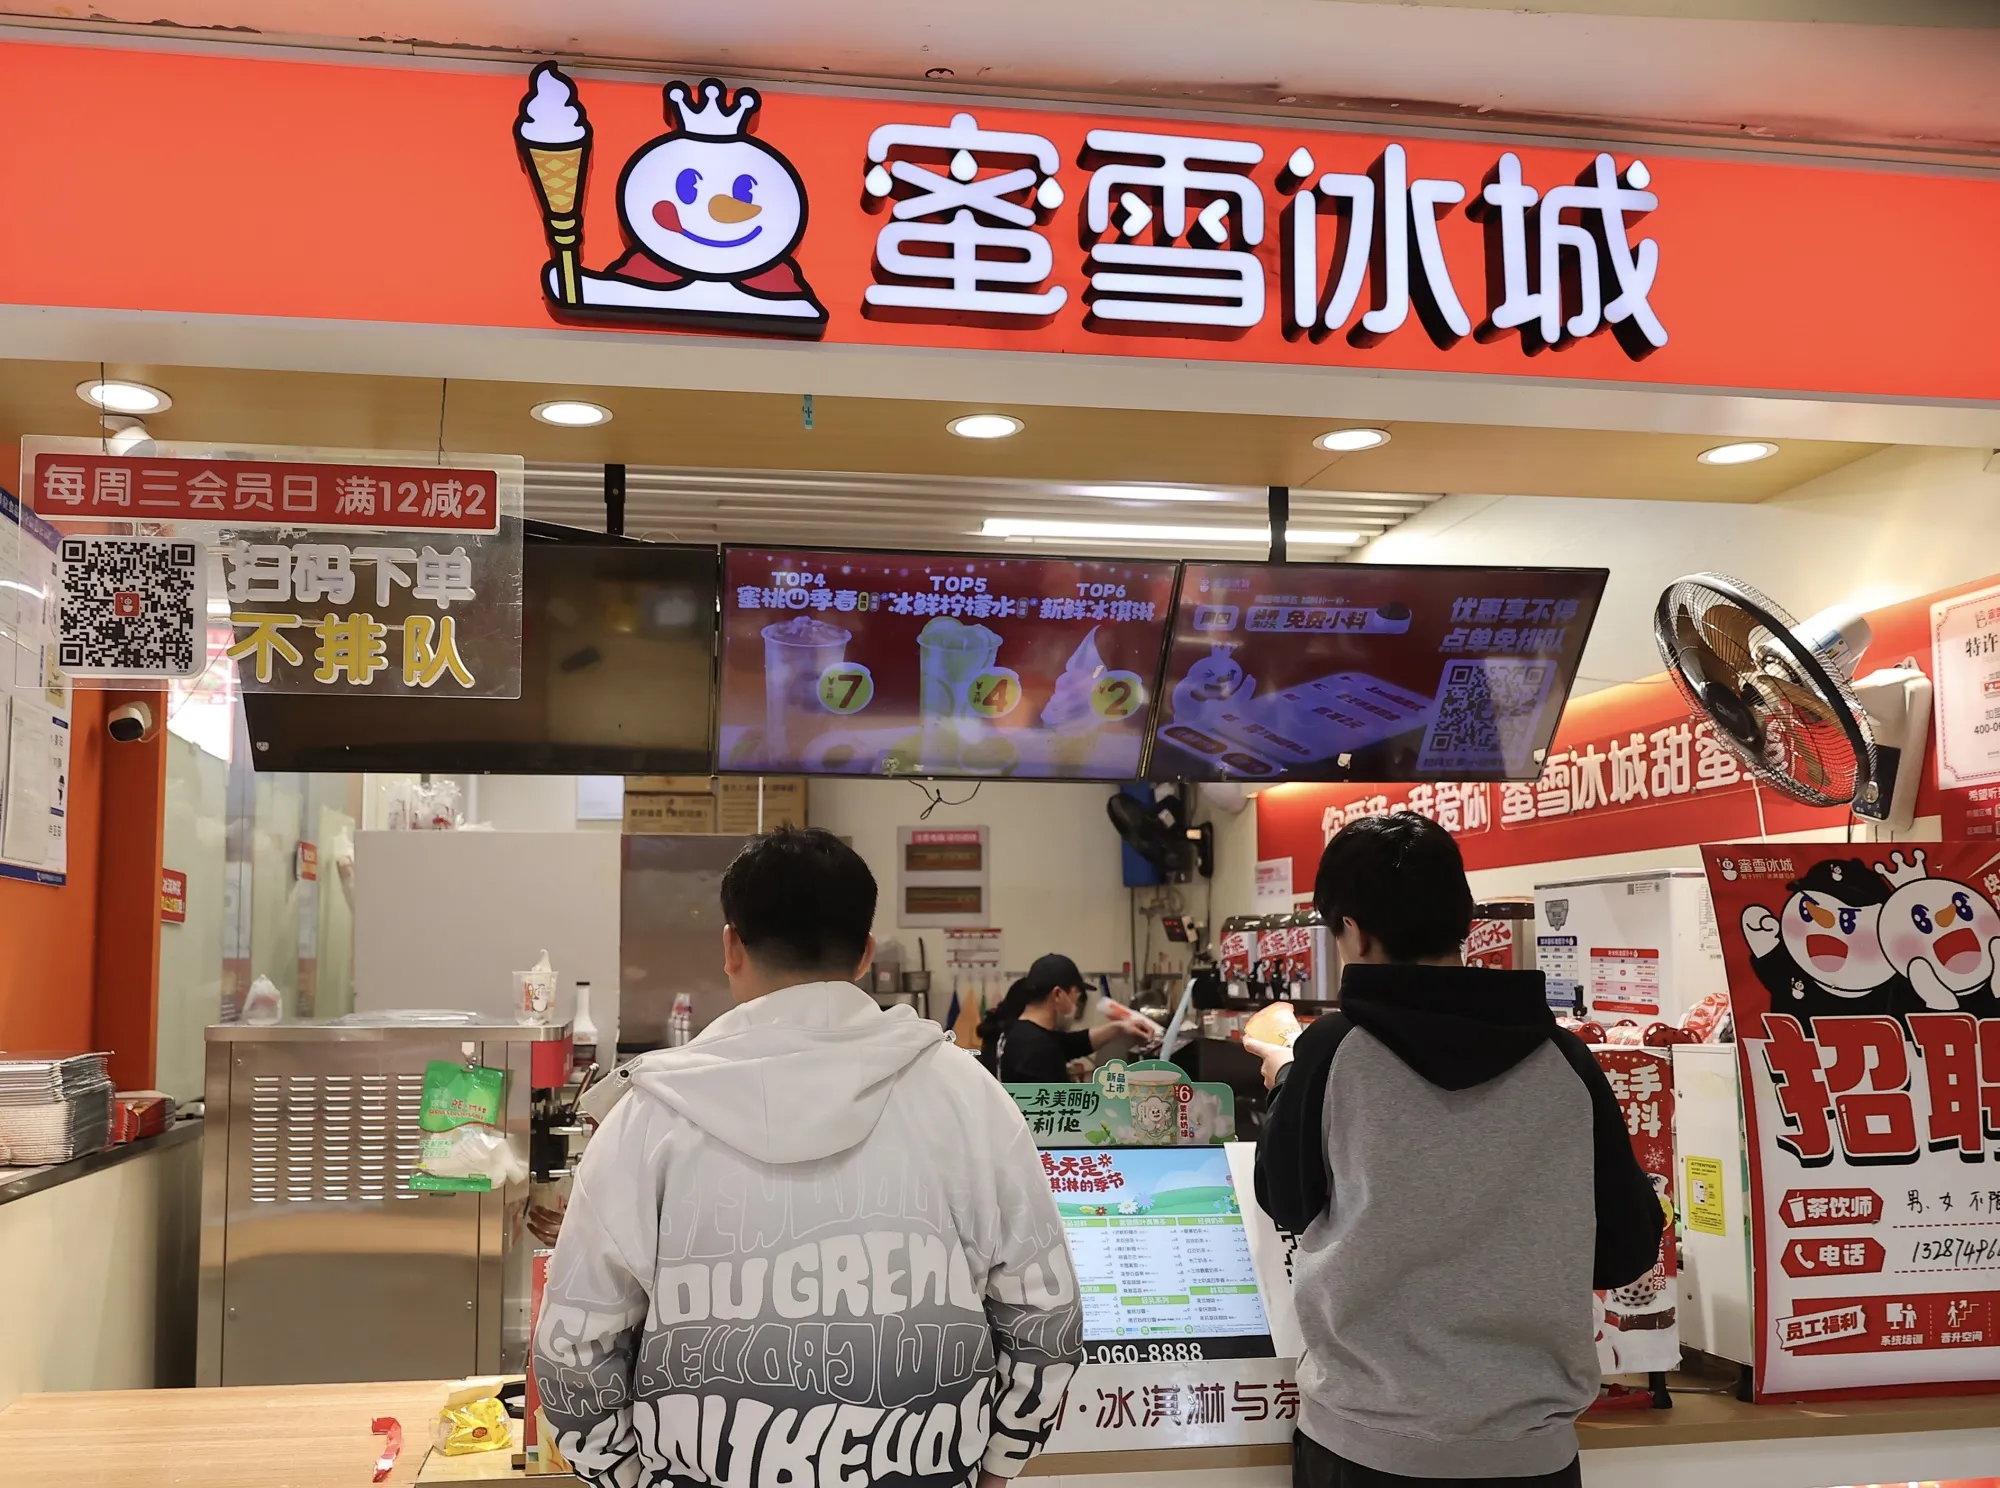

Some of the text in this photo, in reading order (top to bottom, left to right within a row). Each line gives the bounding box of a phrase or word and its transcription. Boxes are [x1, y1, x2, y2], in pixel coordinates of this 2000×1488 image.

[864, 113, 1670, 350] 蜜雪冰城
[43, 463, 487, 519] 每周三会员日 满12减2
[228, 540, 477, 609] 扫码下单
[771, 571, 826, 587] TOP4
[929, 575, 988, 592] TOP5
[1076, 582, 1127, 599] TOP6
[888, 592, 1017, 618] 冰鲜柠檬水
[1040, 597, 1156, 622] 新鲜冰淇淋
[1450, 597, 1579, 623] 优惠享不停
[227, 612, 476, 688] 不排队
[1737, 857, 1795, 873] 蜜雪冰城
[1106, 1071, 1126, 1082] 新品
[1106, 1083, 1125, 1093] 上市
[1604, 1063, 1662, 1101] 在手
[1008, 1088, 1100, 1117] 一朵美丽的
[1807, 1196, 1873, 1219] 茶饮师
[1818, 1243, 1866, 1267] 电话
[1786, 1311, 1859, 1341] 员工福利
[1941, 1331, 1983, 1344] 晋升空间
[1880, 1333, 1924, 1346] 系统培训
[1056, 1379, 1300, 1432] ·冰淇淋与茶
